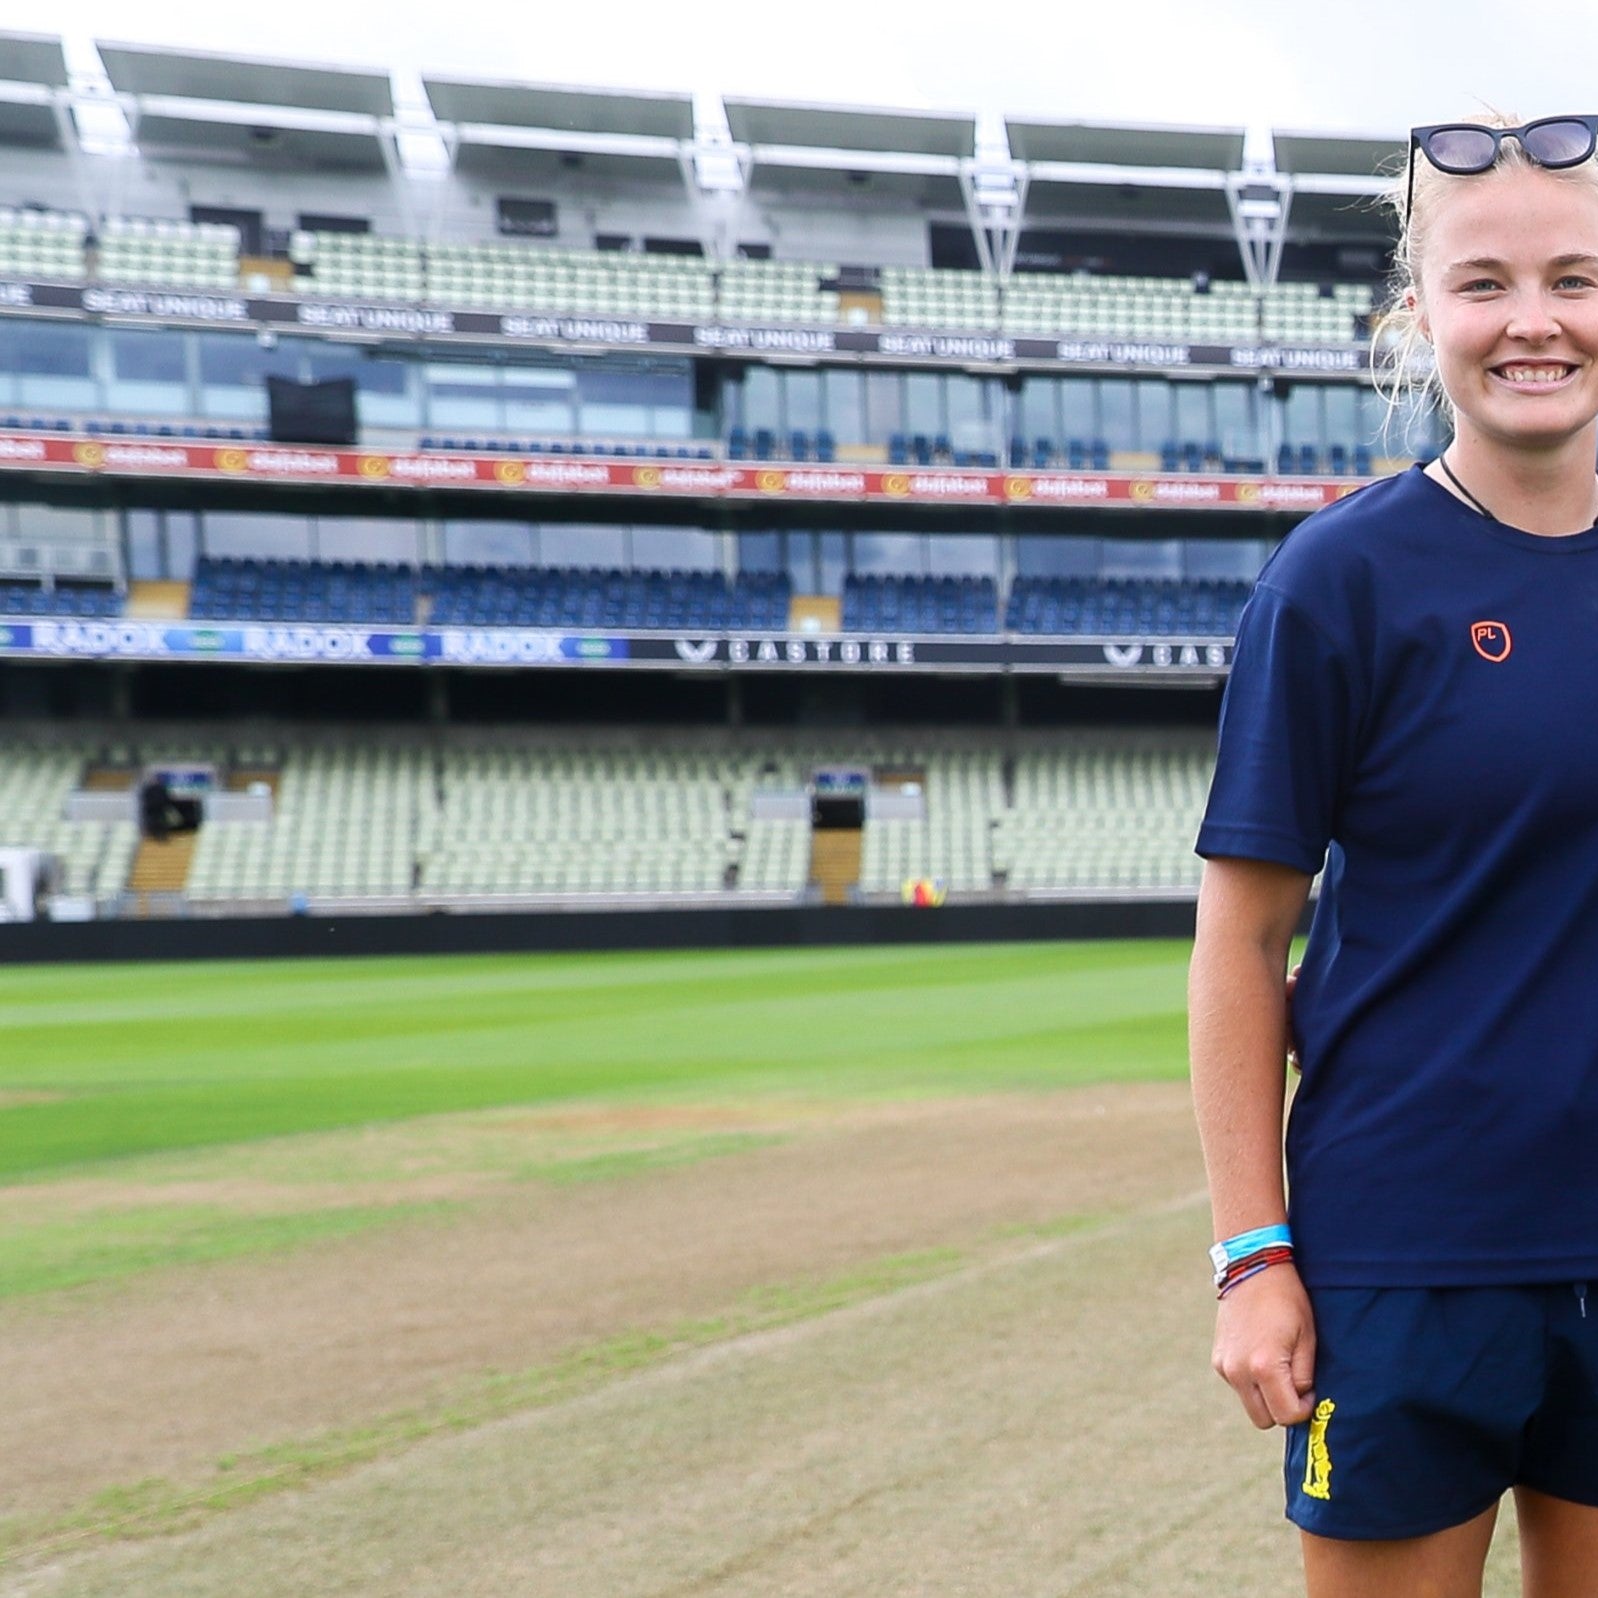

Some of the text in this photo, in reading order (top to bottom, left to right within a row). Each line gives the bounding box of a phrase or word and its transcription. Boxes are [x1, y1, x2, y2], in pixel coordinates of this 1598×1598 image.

[33, 622, 165, 655] RADOX
[242, 627, 373, 659] RADOX
[443, 630, 563, 661] RADOX
[729, 639, 915, 664] CASTORE
